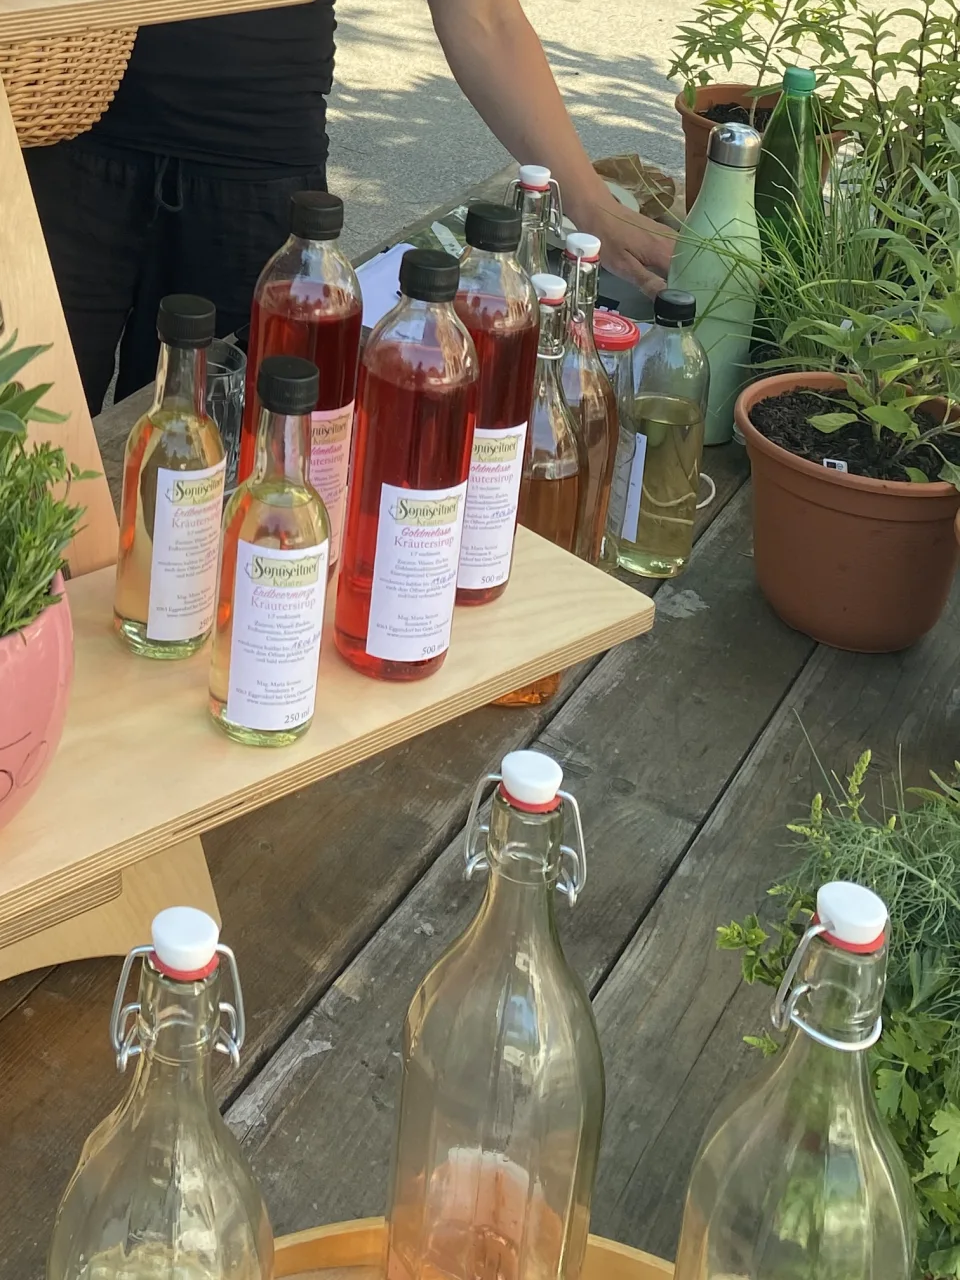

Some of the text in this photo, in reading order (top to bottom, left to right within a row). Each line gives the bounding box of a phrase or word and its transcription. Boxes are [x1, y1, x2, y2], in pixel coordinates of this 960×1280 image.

[473, 441, 516, 456] onnseitner
[470, 464, 511, 473] oldmelisse
[398, 500, 457, 520] Sonnseitner
[401, 526, 452, 538] Goldmelisse
[394, 535, 455, 549] Kräutersirup
[254, 556, 318, 580] Sonnseitner
[480, 574, 495, 584] 500
[253, 586, 316, 601] Erdbeerminze
[251, 596, 317, 611] Kräutersirup
[421, 646, 437, 657] 500
[284, 706, 310, 725] 250 ml
